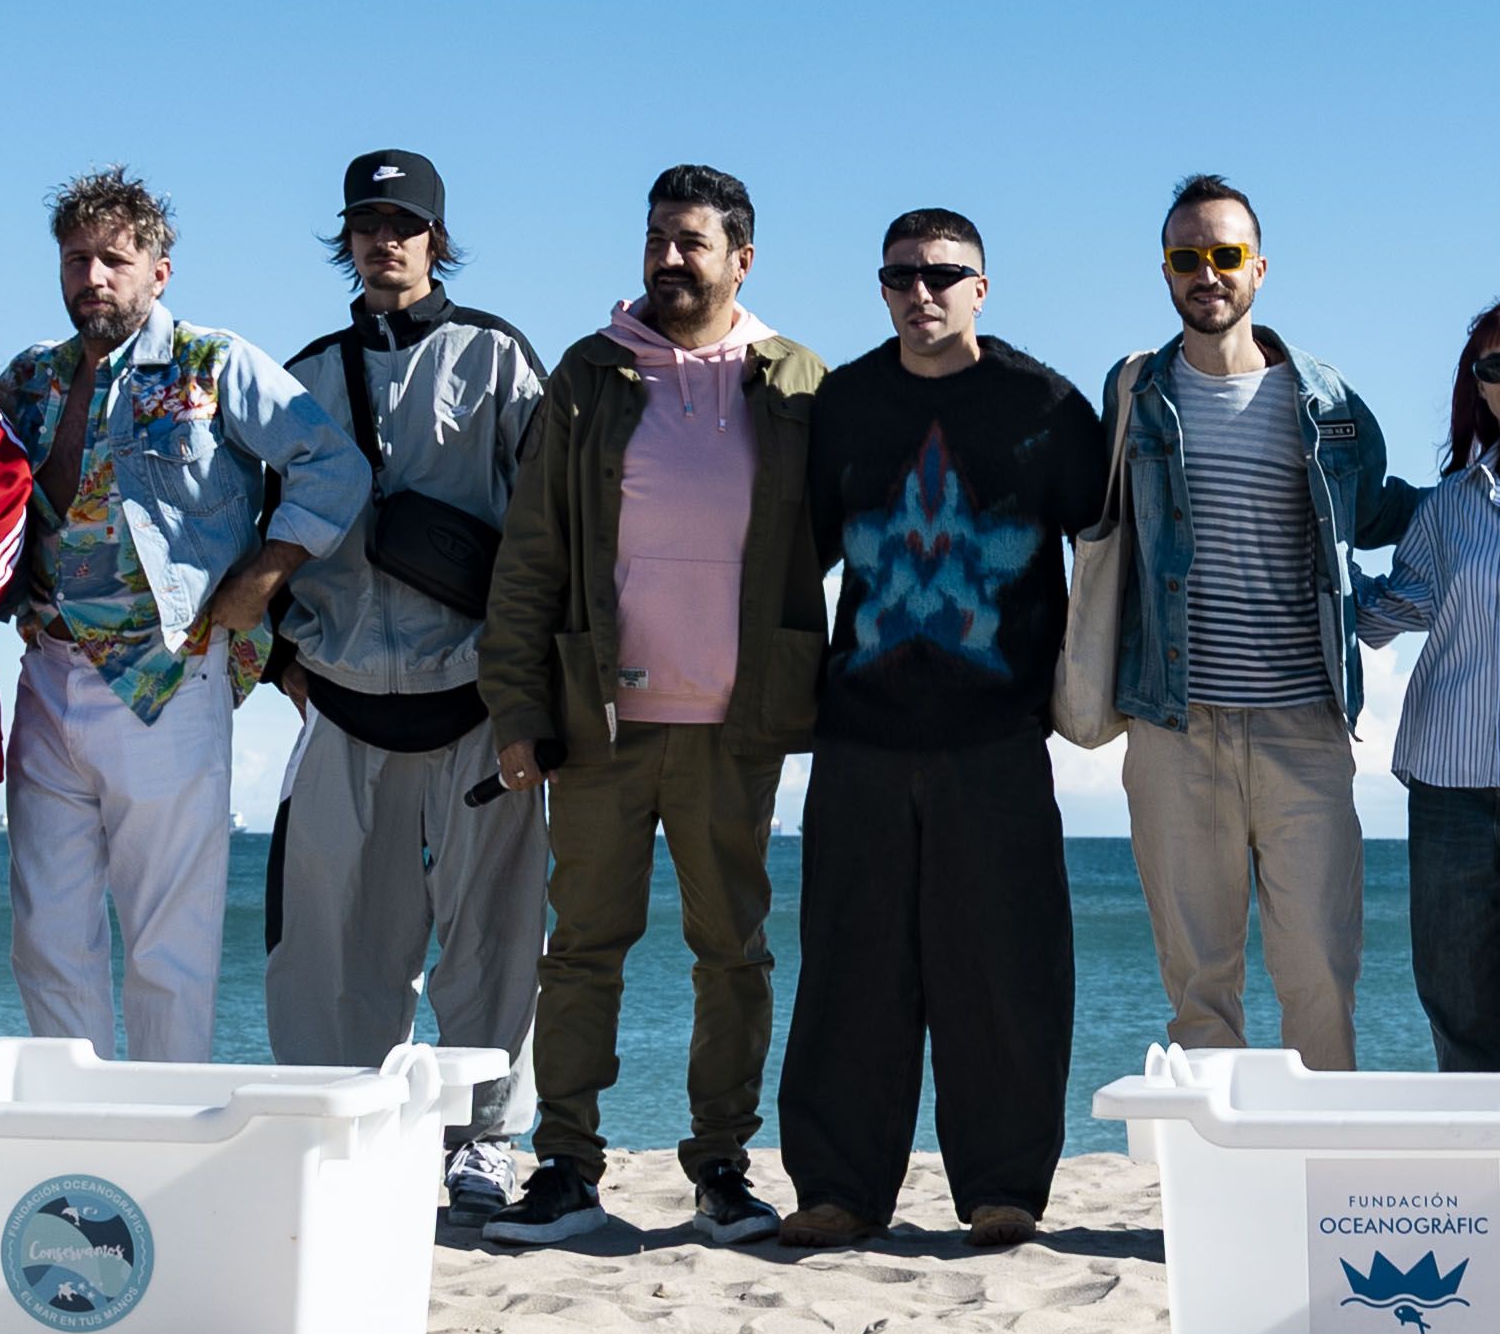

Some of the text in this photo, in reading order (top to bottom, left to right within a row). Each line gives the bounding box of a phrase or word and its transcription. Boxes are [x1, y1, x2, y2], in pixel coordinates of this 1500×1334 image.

[1349, 1192, 1458, 1208] FUNDACIÓN
[1319, 1213, 1489, 1235] OCEANOGRÀFIC
[20, 1285, 138, 1327] EL MAR EN TUS MANOS
